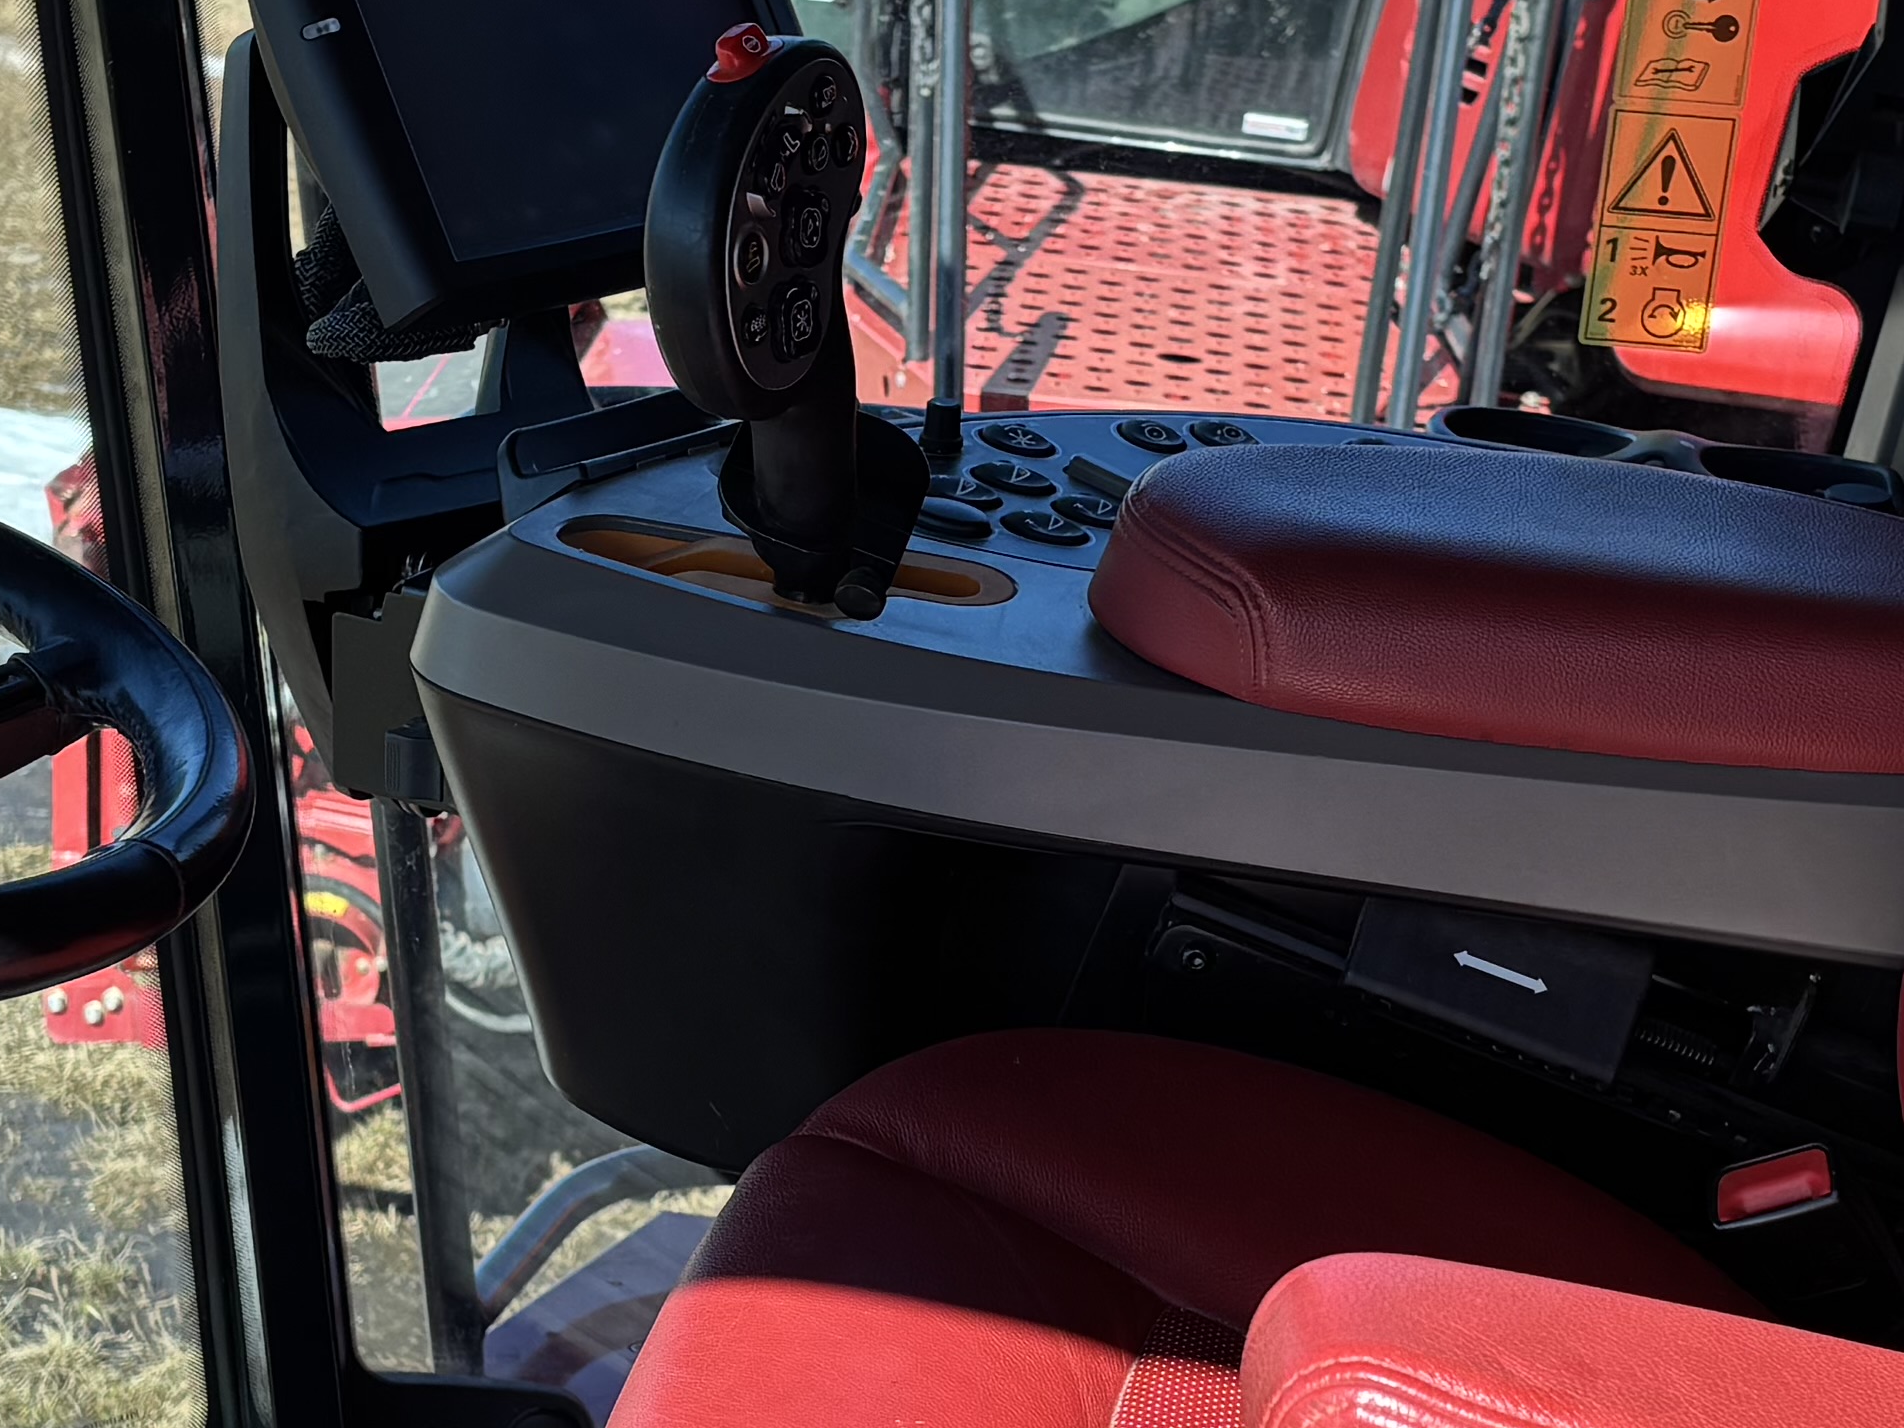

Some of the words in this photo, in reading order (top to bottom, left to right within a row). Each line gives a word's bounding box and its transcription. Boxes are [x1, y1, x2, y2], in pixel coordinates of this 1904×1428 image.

[1606, 236, 1619, 263] 1
[1629, 265, 1649, 277] 3X
[1597, 297, 1618, 324] 2
